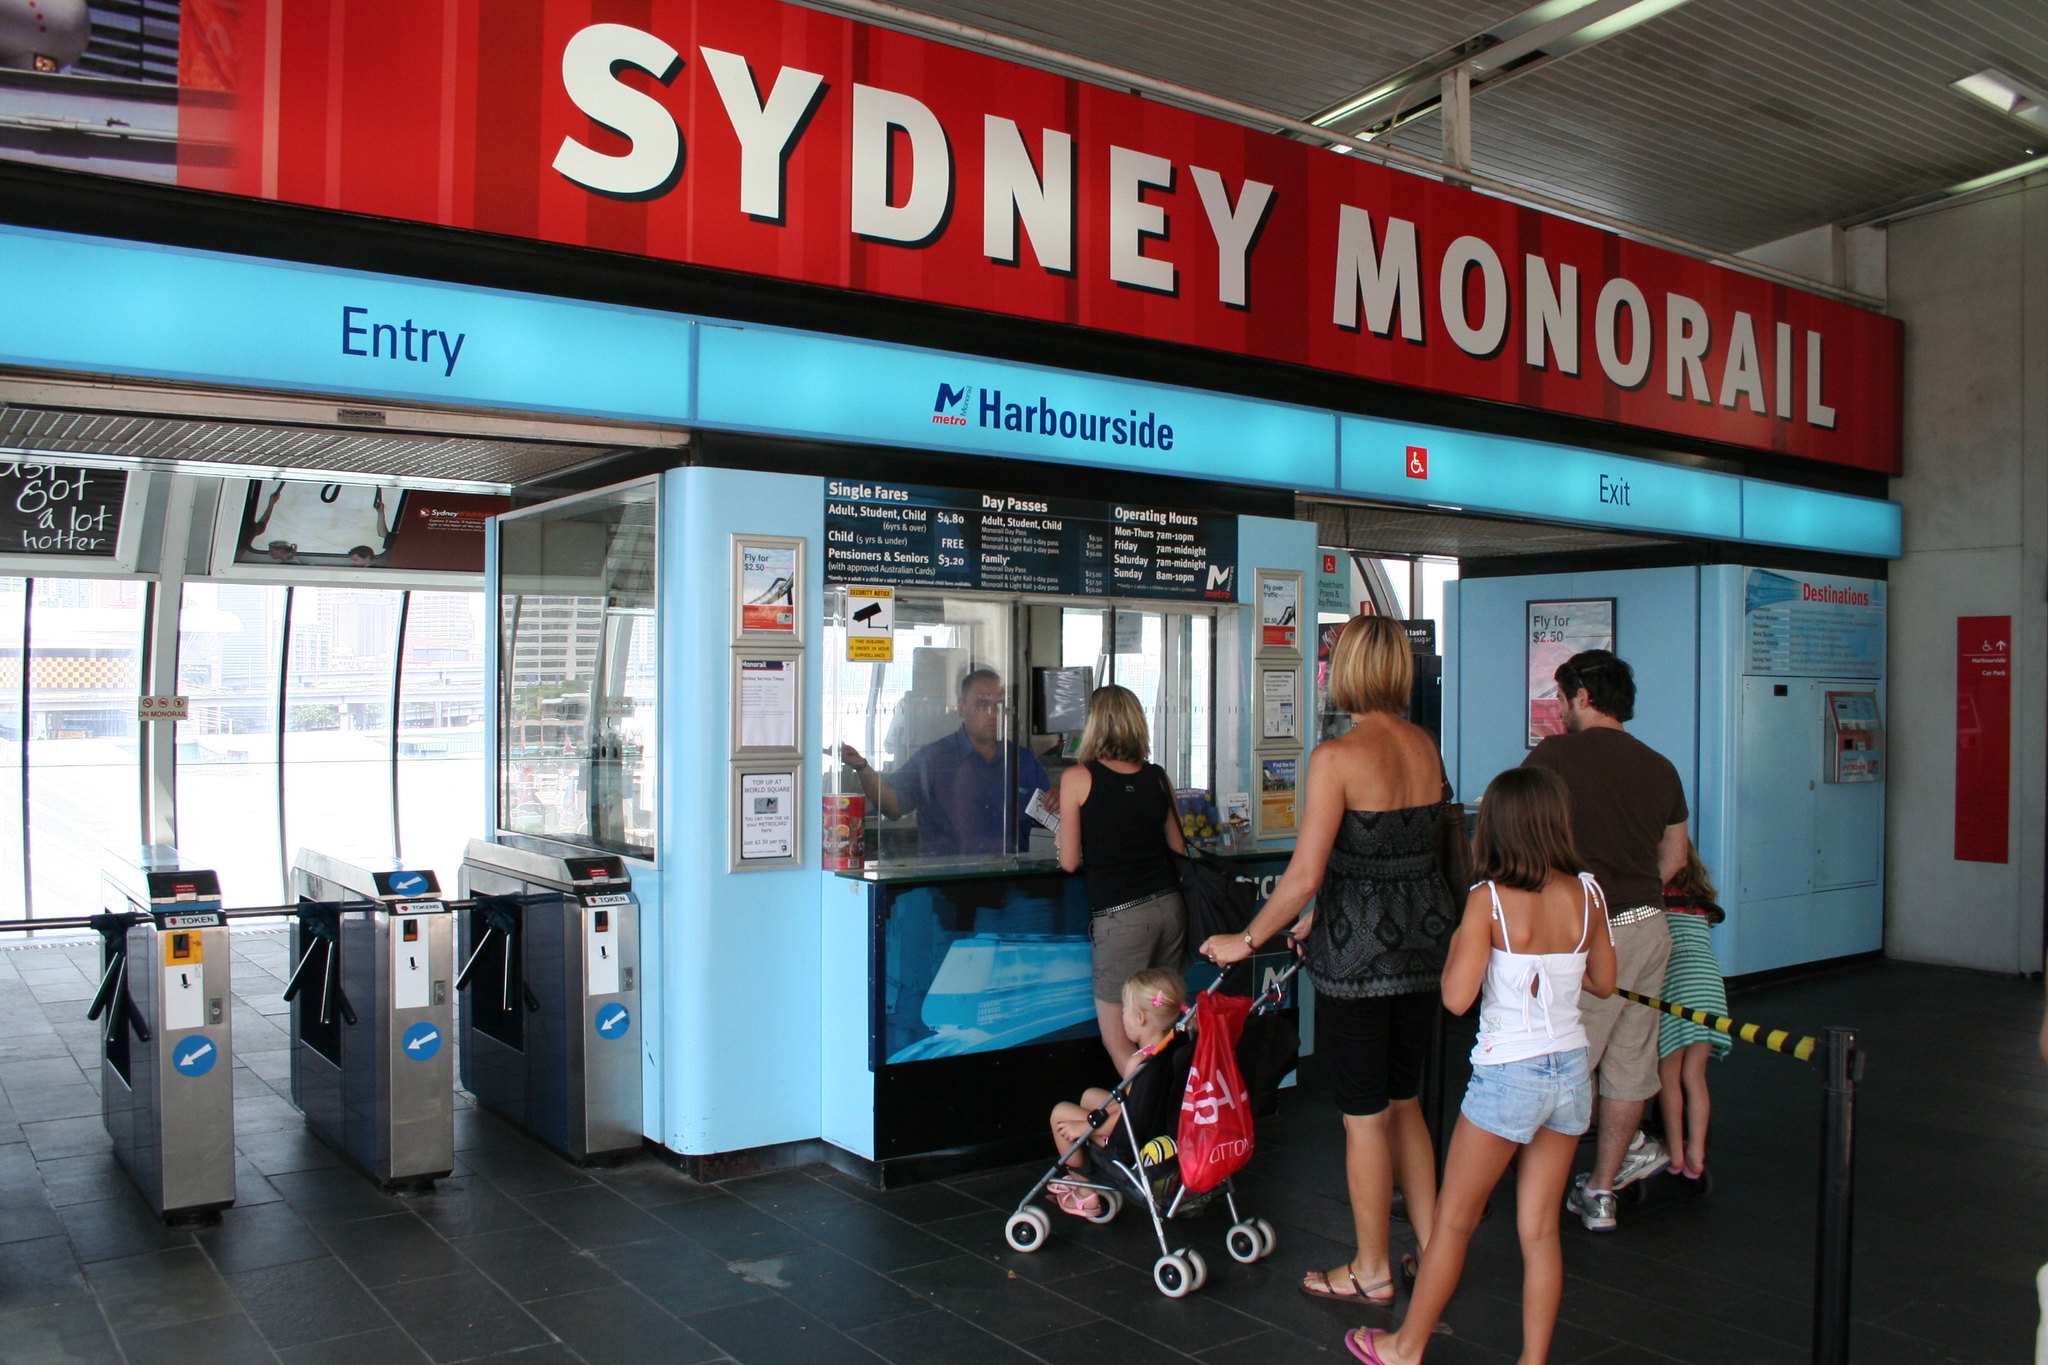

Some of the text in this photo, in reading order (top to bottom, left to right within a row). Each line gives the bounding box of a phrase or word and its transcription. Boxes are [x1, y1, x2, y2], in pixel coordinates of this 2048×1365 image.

[552, 22, 1838, 430] SYDNEY MONORAIL
[342, 305, 466, 377] Entry
[931, 413, 967, 426] metro
[979, 387, 1174, 451] Harbourside
[16, 468, 95, 513] got
[829, 482, 909, 501] Single Fares
[1599, 473, 1631, 506] Exit
[982, 495, 1048, 512] Day Passes
[37, 504, 113, 531] a lot
[828, 504, 927, 521] Adult, Student, Child
[937, 512, 965, 525] $4.80
[1115, 507, 1198, 526] Operating Hours
[902, 523, 908, 531] &
[909, 524, 927, 533] over)
[981, 516, 1062, 530] Adult, Student, Child
[23, 529, 106, 551] hotter
[828, 530, 854, 542] Child
[865, 537, 876, 545] yrs
[877, 536, 883, 544] &
[884, 536, 908, 546] under)
[1114, 526, 1194, 542] Mon-Thurs 7am-10pm
[941, 538, 965, 549] FREE
[1114, 540, 1206, 558] Friday 7am-midnight
[744, 554, 768, 563] Fly for
[828, 548, 929, 564] Pensioners & Seniors
[938, 554, 965, 567] $3.20
[1114, 554, 1206, 571] Saturday 7am-midnight
[744, 564, 764, 572] $2.50
[828, 563, 936, 576] (with approved Australian Cards)
[1114, 568, 1194, 584] Sunday 8am-10pm
[1204, 590, 1232, 599] metro
[1803, 582, 1869, 606] Destinations
[1533, 615, 1570, 630] Fly for
[1413, 636, 1432, 644] sugar
[1533, 630, 1564, 644] $2.50
[151, 710, 188, 718] MONORAIL
[180, 916, 214, 924] TOKEN
